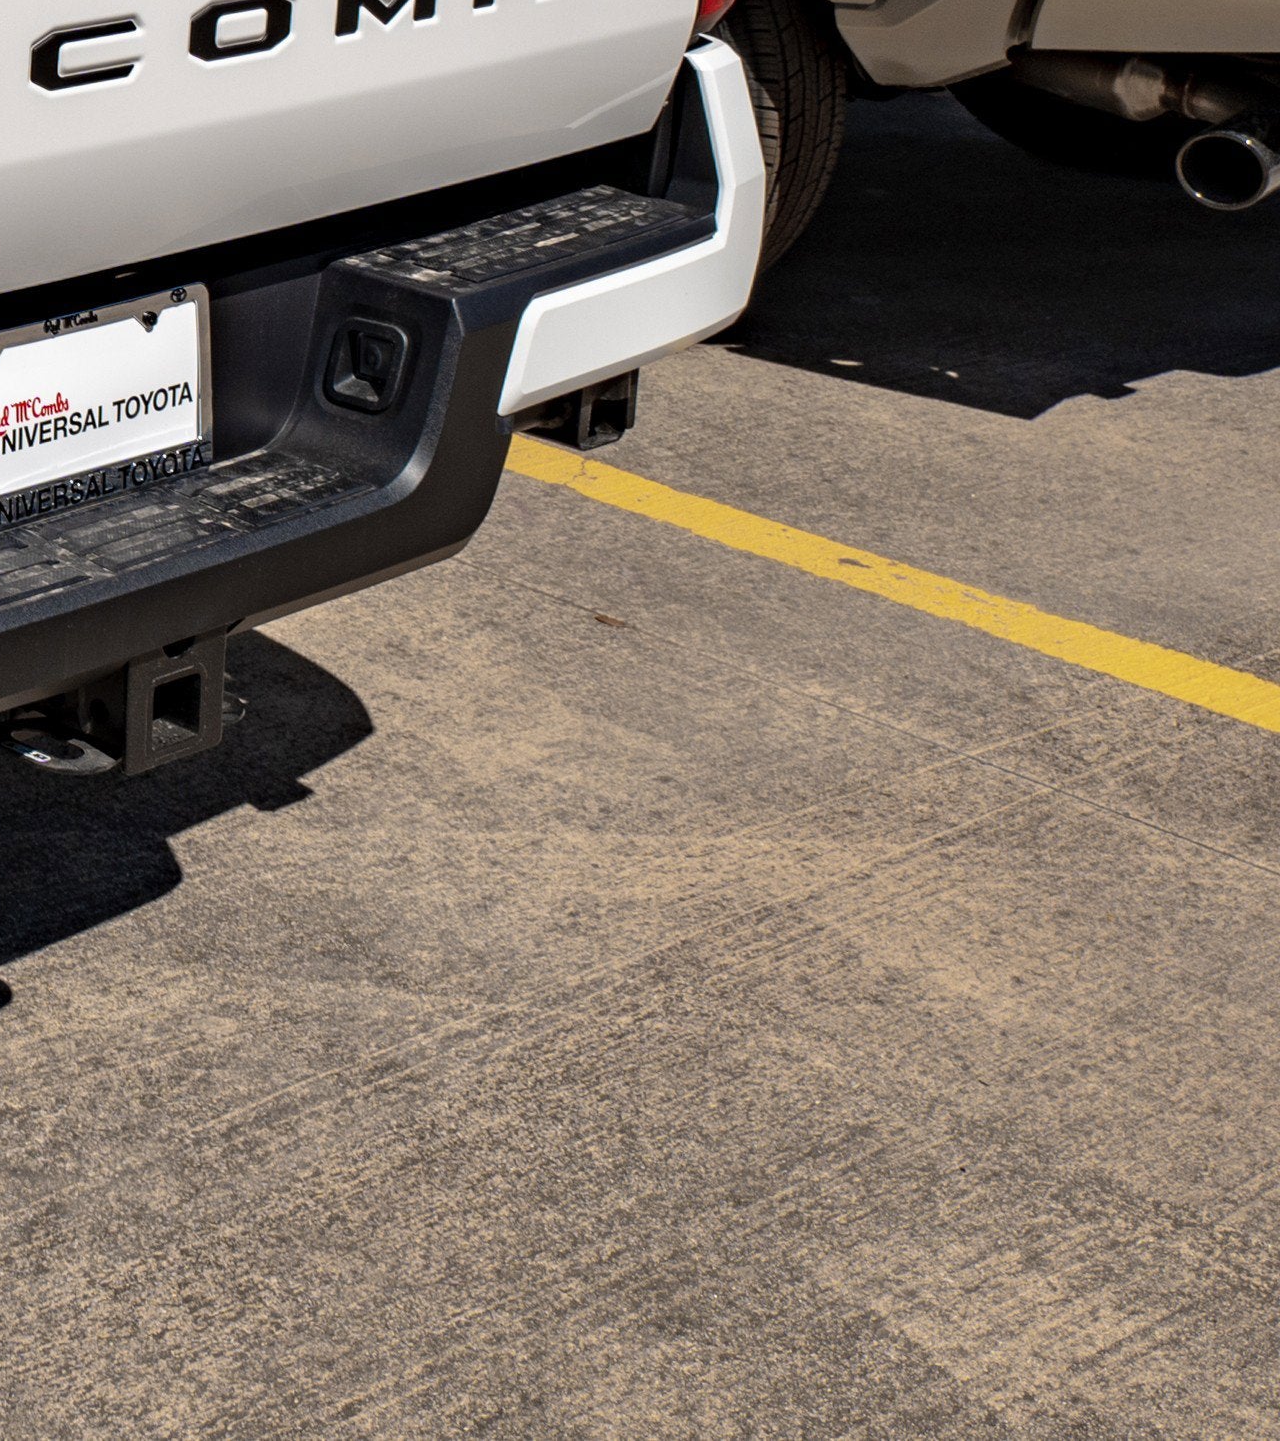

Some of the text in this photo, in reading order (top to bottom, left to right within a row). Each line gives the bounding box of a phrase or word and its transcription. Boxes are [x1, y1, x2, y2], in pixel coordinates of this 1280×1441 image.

[11, 392, 70, 424] McCombs
[112, 381, 193, 423] TOYOTA
[118, 442, 205, 489] TOYOTA
